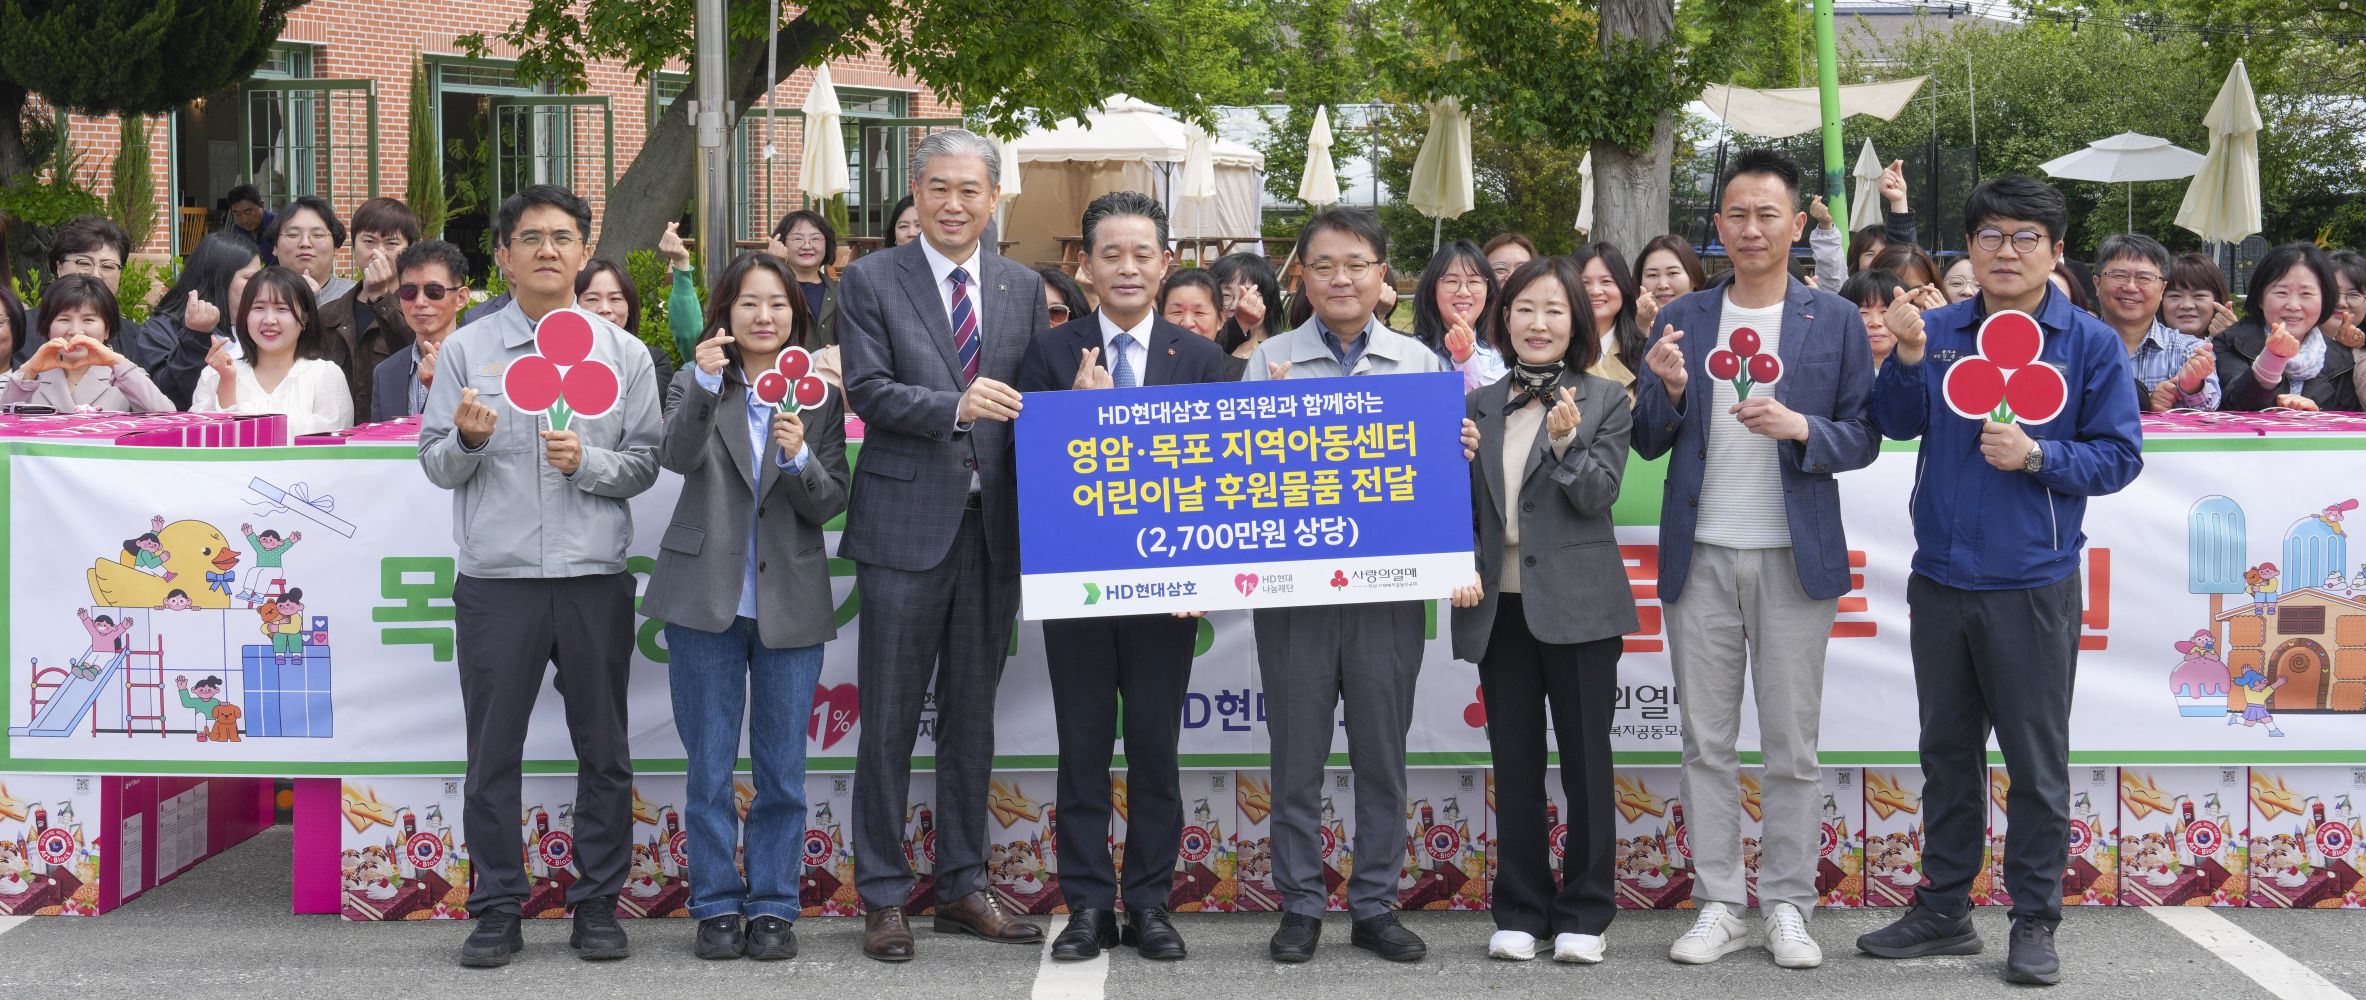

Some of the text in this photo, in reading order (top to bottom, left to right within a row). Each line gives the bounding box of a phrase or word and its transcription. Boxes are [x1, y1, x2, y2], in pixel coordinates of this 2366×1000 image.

[1098, 391, 1384, 425] HD현대삼호 임직원과 함께하는
[1067, 420, 1417, 474] 영암·목포 지역아동센터
[1072, 465, 1417, 517] 어린이날 후원물품 전달
[1136, 516, 1359, 558] (2,700만원 상당)
[1262, 573, 1293, 584] HD현대
[1352, 567, 1417, 583] 사랑의열매
[1106, 580, 1197, 600] HD현대삼호
[1262, 584, 1294, 594] 나눔재단
